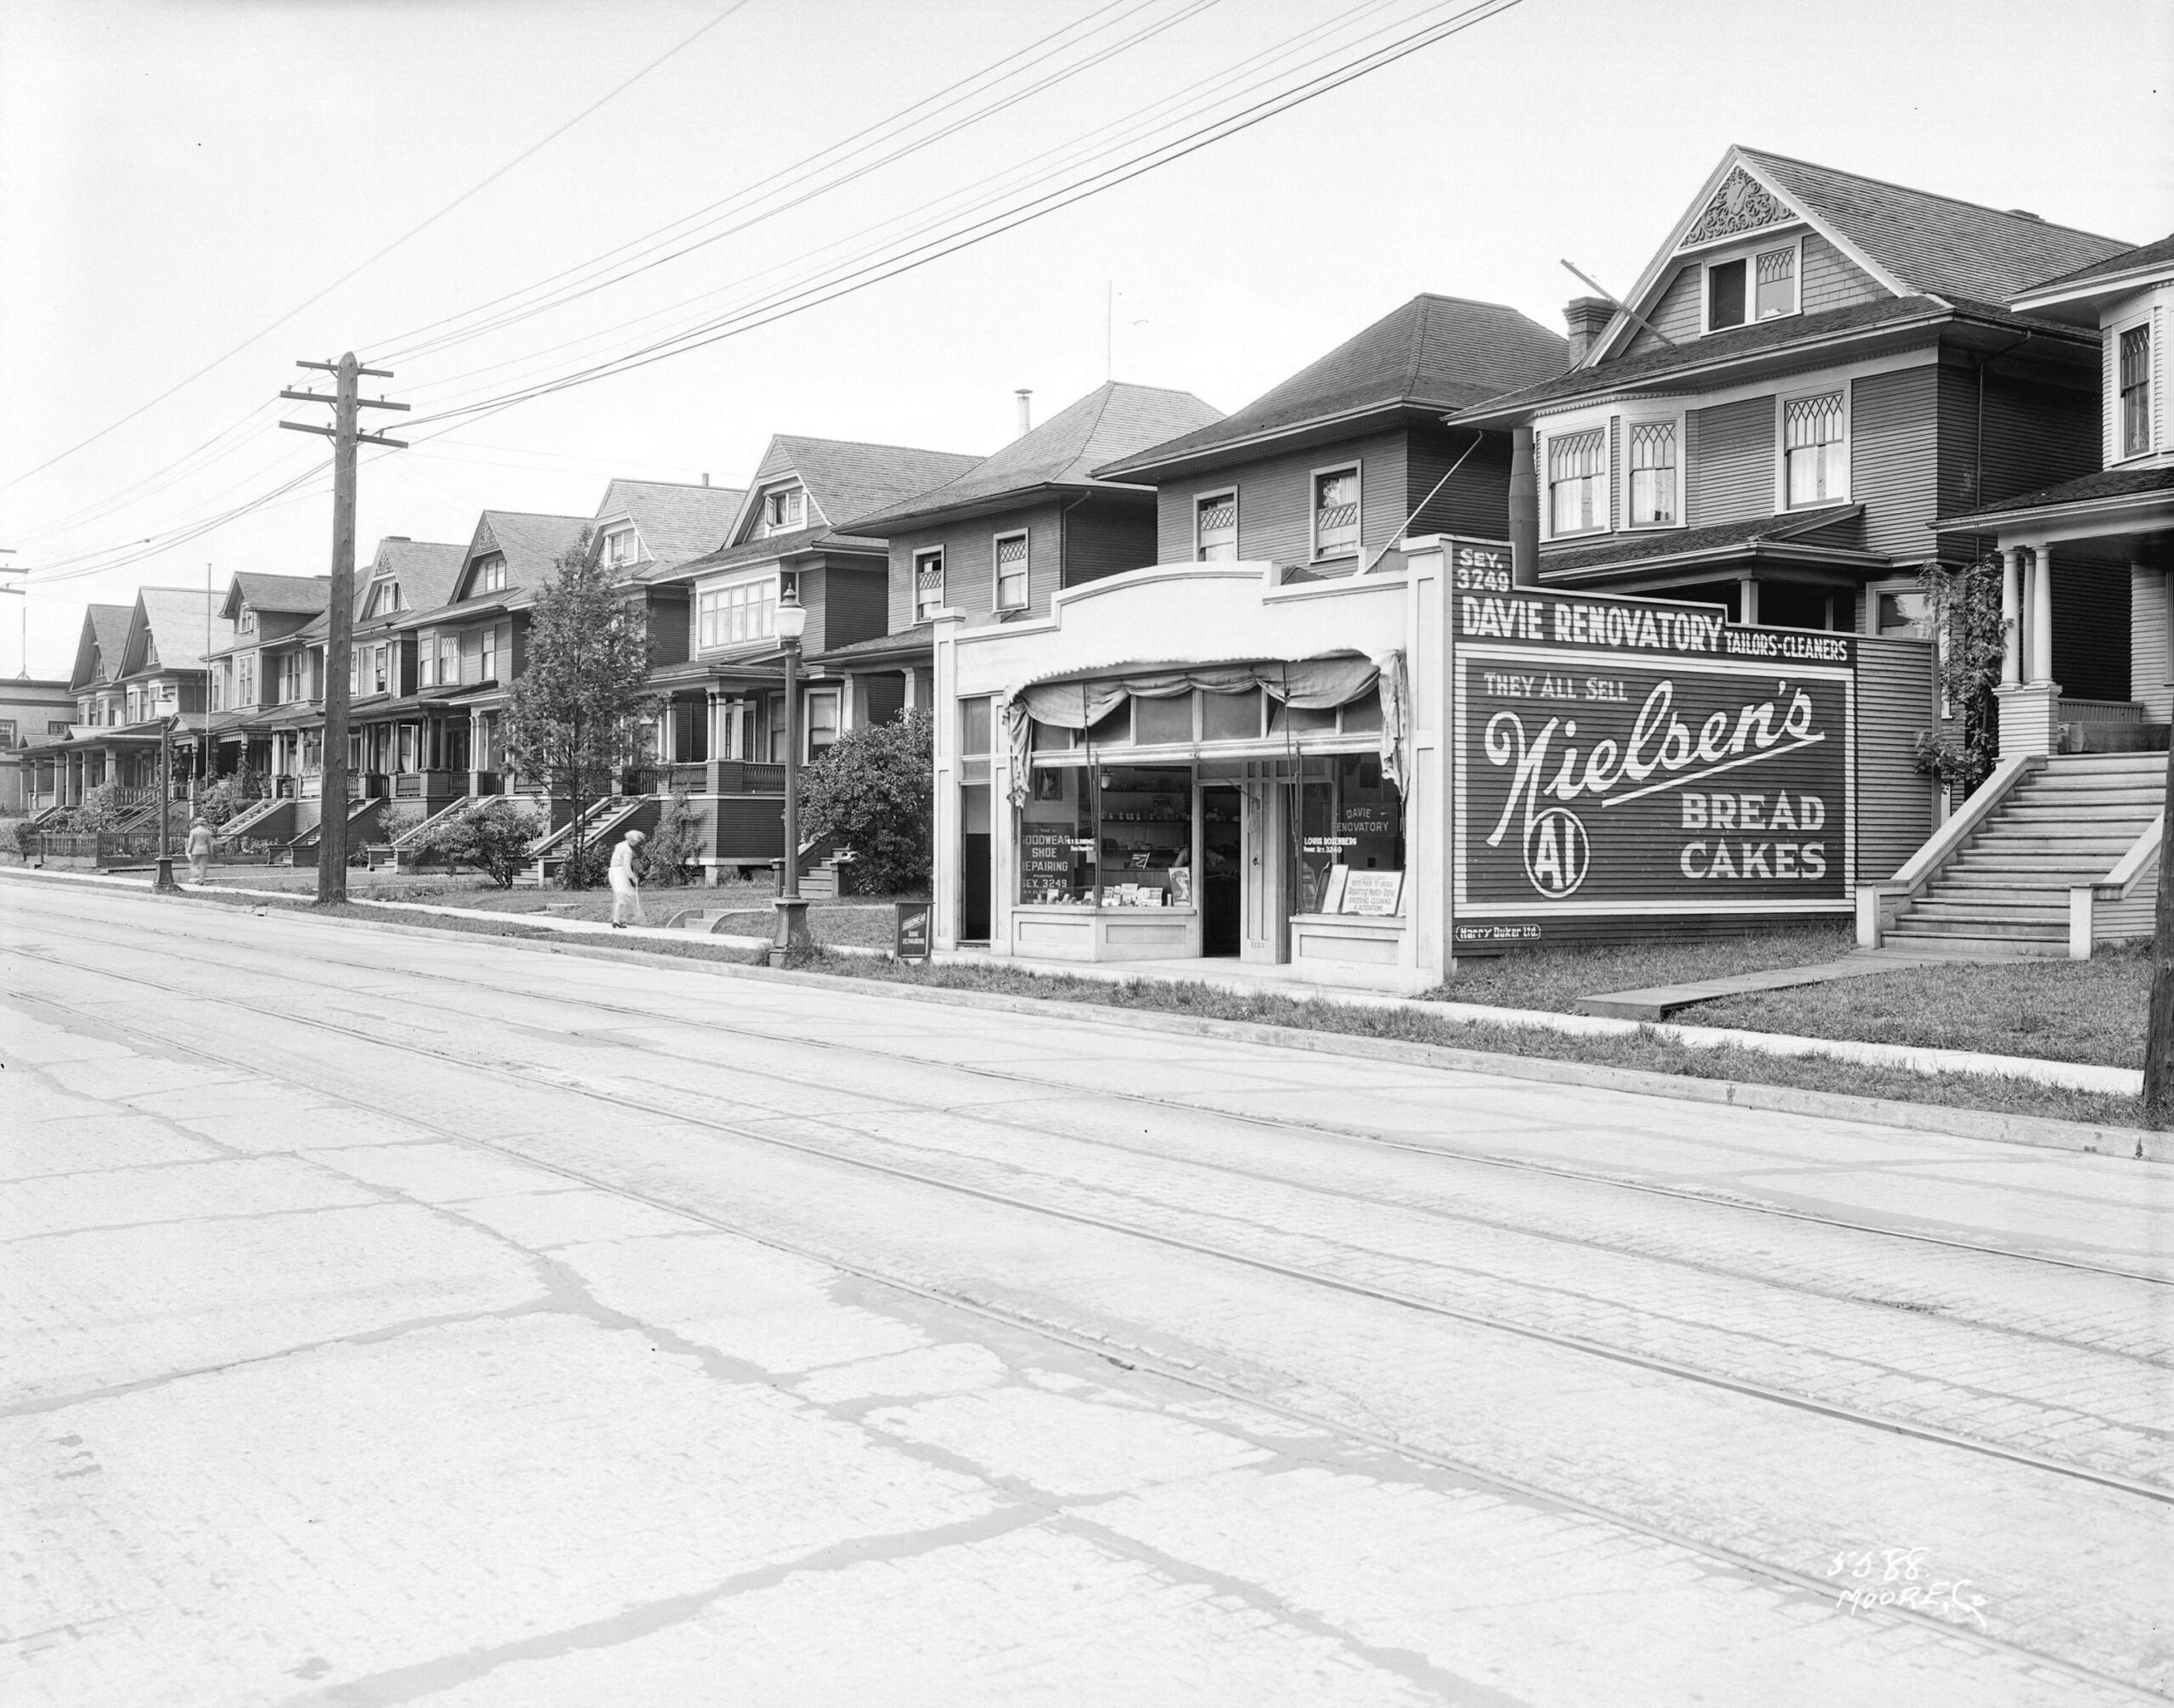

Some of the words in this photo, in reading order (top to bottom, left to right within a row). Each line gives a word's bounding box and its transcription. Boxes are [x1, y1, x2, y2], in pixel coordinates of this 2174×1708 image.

[1459, 548, 1503, 569] SEY.
[1456, 568, 1509, 592] 3249
[1462, 596, 1544, 640] DAVIE
[1554, 603, 1723, 652] RENOVATORY
[1484, 672, 1535, 696] THEY
[1540, 673, 1577, 699] ALL
[1585, 677, 1628, 702] SELL
[1484, 679, 1826, 848] Nielsen's
[1346, 808, 1371, 819] DAVIE
[1681, 790, 1825, 830] BREAD
[1304, 837, 1322, 845] LOUIS
[1323, 837, 1357, 846] ROSENBERG
[1032, 848, 1056, 858] SHOE
[1681, 837, 1827, 880] CAKES
[1042, 879, 1067, 888] 3249
[1461, 927, 1492, 939] Harry
[1523, 926, 1538, 937] Ltd.
